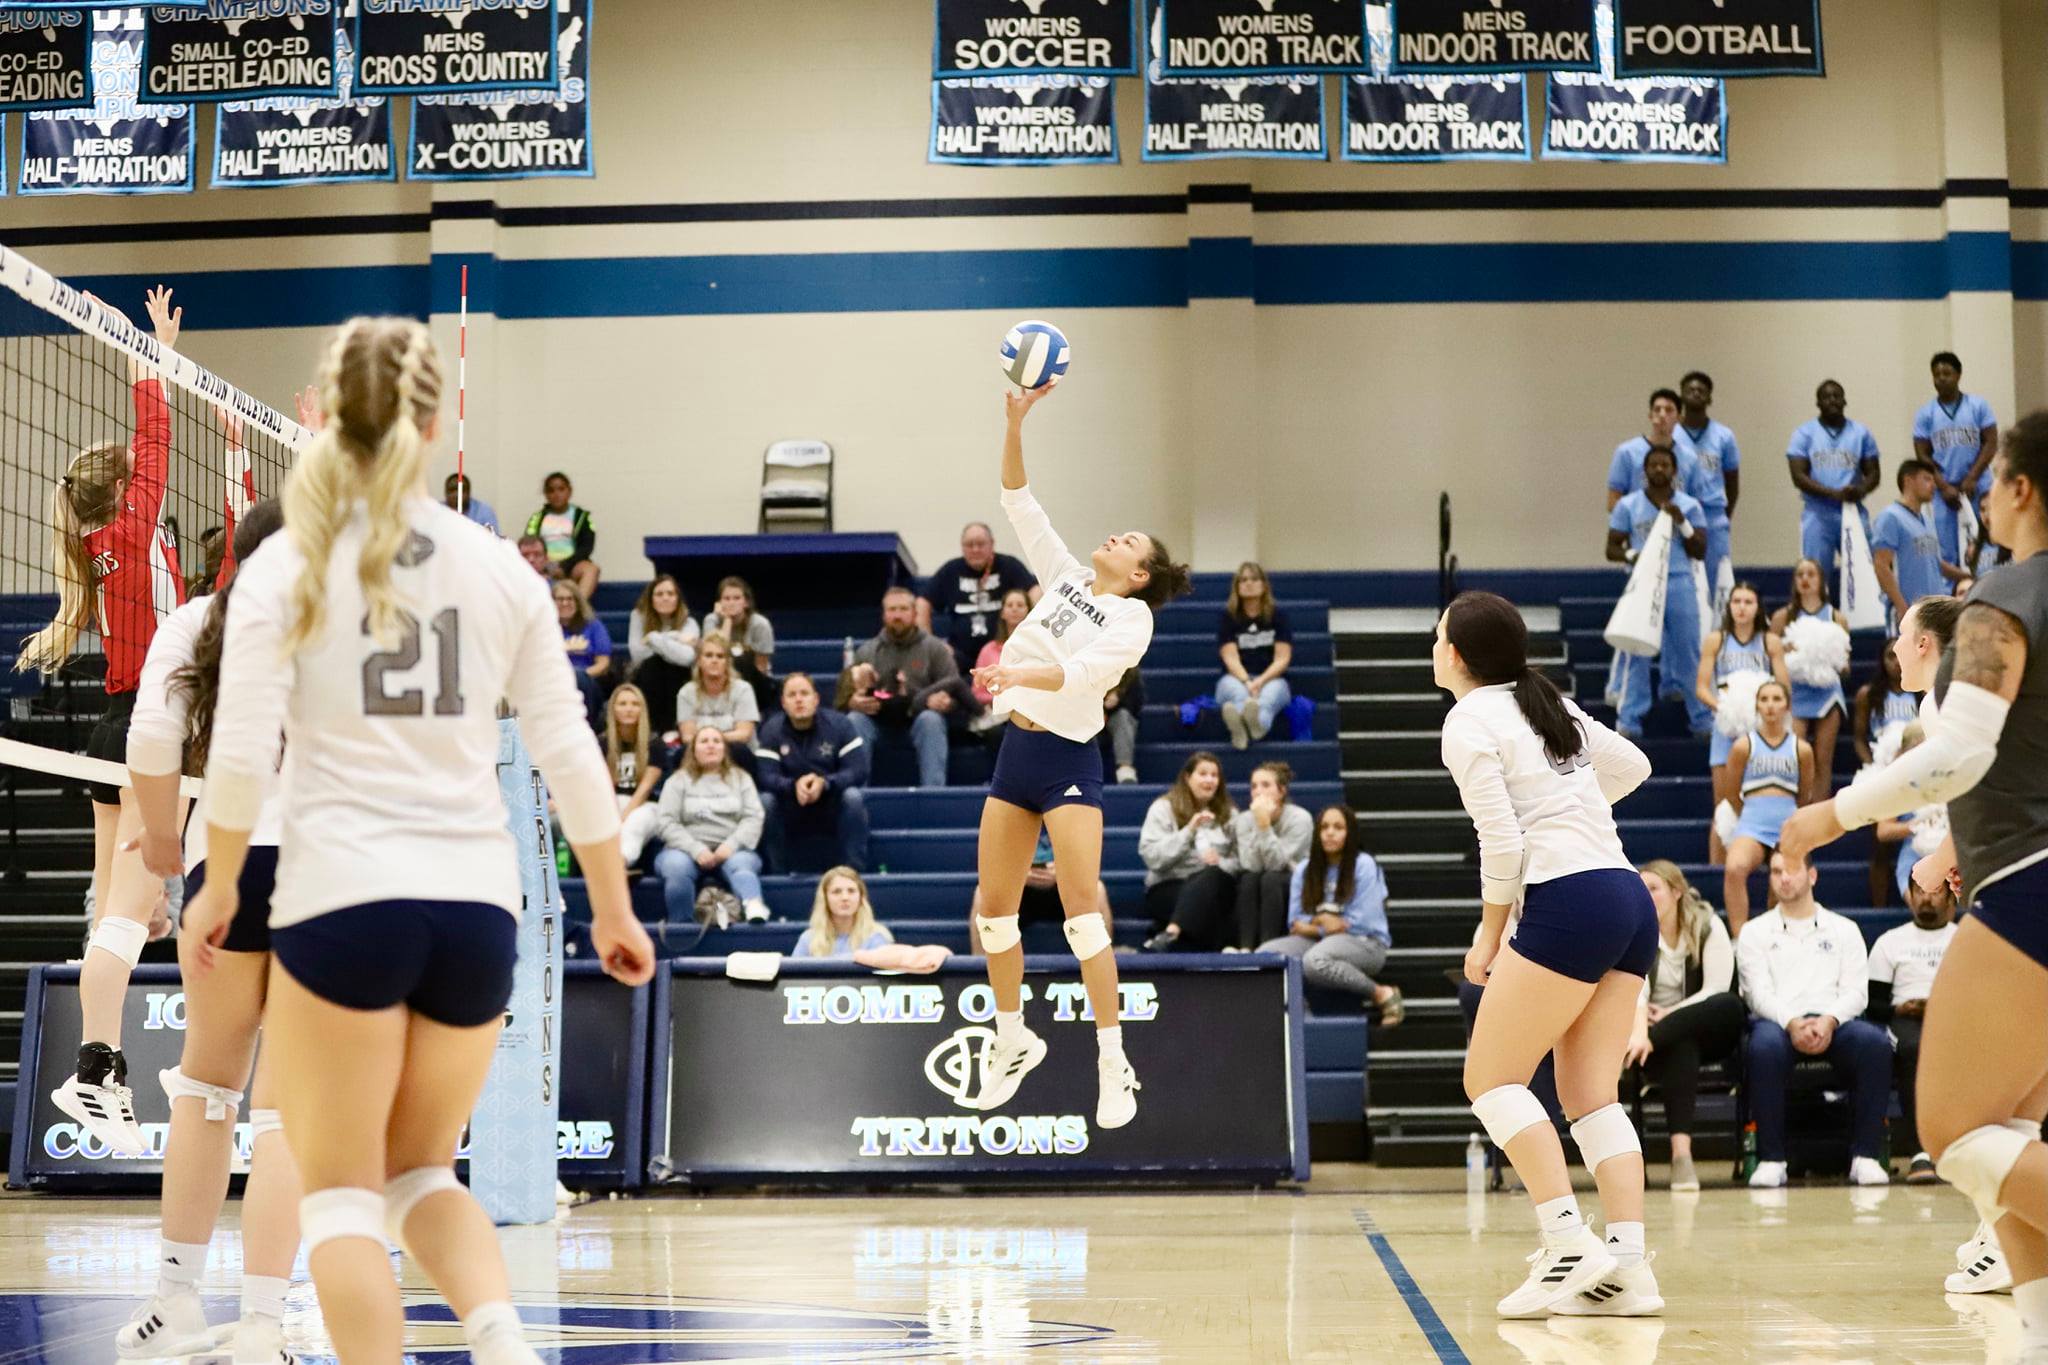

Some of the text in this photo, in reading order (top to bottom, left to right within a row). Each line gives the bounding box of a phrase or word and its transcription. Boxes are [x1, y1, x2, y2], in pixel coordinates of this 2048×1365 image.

[985, 17, 1081, 39] WOMENS
[1217, 14, 1313, 36] WOMENS
[1462, 11, 1526, 32] MENS
[170, 37, 310, 63] SMALL CO-ED
[423, 32, 485, 53] MENS
[955, 38, 1112, 70] SOCCER
[1169, 36, 1268, 67] INDOOR
[1281, 34, 1363, 64] TRACK
[1399, 33, 1497, 62] INDOOR
[1506, 32, 1590, 61] TRACK
[1624, 25, 1812, 56] FOOTBALL
[150, 57, 331, 94] CHEERLEADING
[361, 51, 548, 85] CROSS COUNTRY
[975, 106, 1076, 125] WOMENS
[1201, 103, 1265, 122] MENS
[1405, 103, 1469, 122] MENS
[1587, 102, 1686, 122] WOMENS
[256, 126, 352, 149] WOMENS
[452, 120, 550, 142] WOMENS
[937, 124, 1111, 153] HALF-MARATHON
[1147, 122, 1320, 151] HALF-MARATHON
[1349, 121, 1524, 150] INDOOR TRACK
[1550, 119, 1720, 151] INDOOR TRACK
[73, 138, 133, 157] MENS
[220, 142, 388, 176] HALF-MARATHON
[414, 138, 584, 170] X-COUNTRY
[22, 155, 187, 184] HALF-MARATHON
[50, 278, 161, 364] TRITON VOLLEYBALL
[193, 366, 283, 434] TRITON VOLLEYBALL
[1041, 603, 1078, 639] 18
[360, 607, 464, 716] 21
[529, 765, 554, 1105] TRITONS
[783, 984, 945, 1024] HOME
[850, 1114, 1089, 1157] TRITONS
